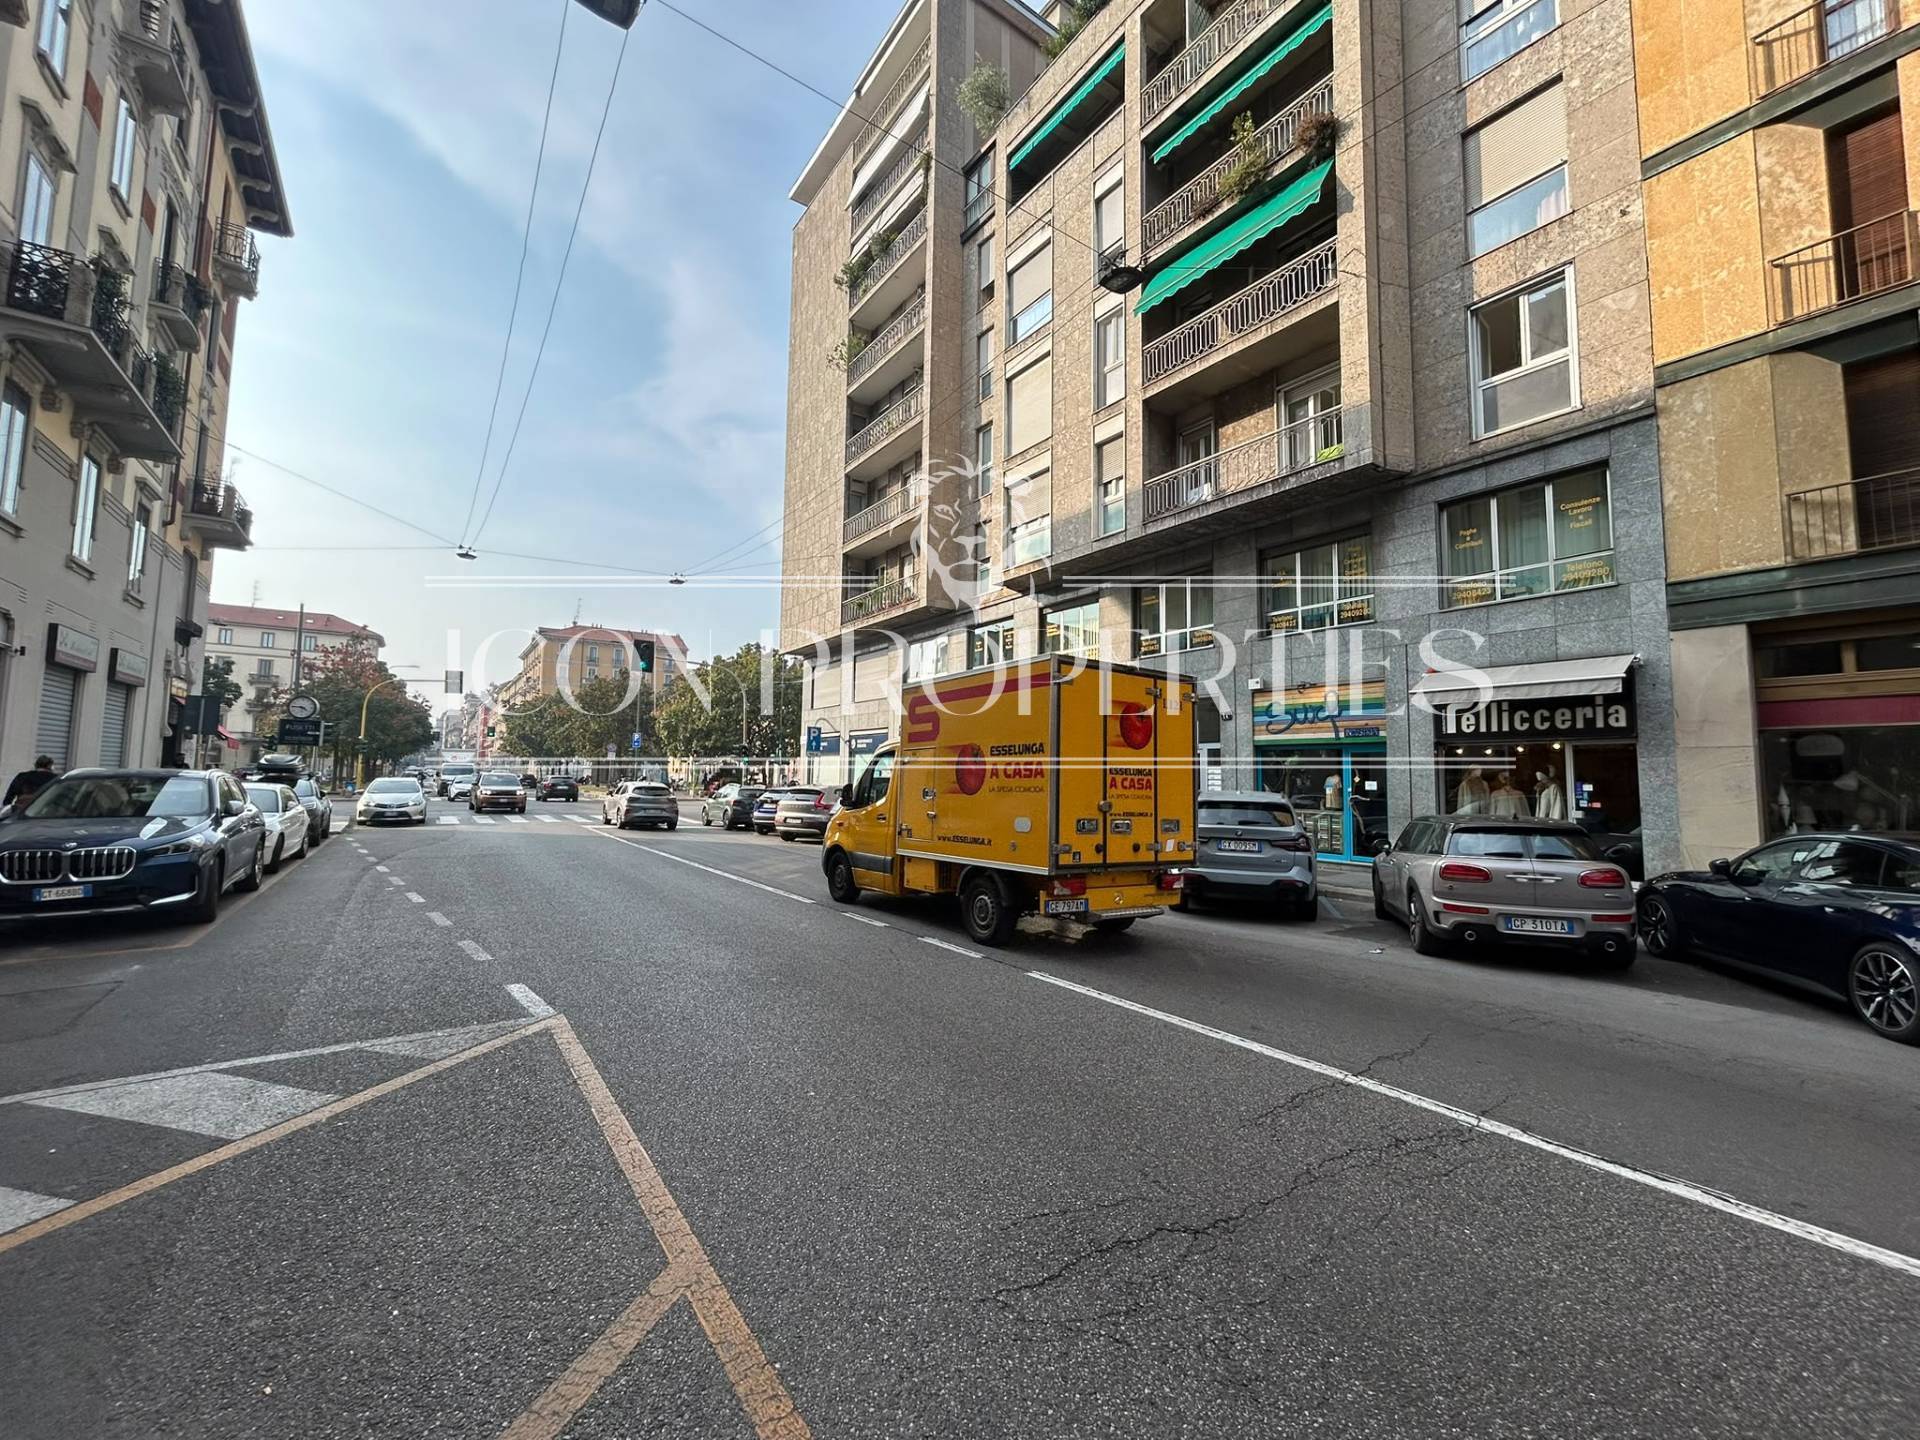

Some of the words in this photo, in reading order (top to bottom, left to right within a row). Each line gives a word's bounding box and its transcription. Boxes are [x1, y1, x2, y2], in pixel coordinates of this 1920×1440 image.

[1568, 505, 1593, 516] Lavoro
[1566, 560, 1604, 573] Telefono
[1446, 695, 1628, 735] Pellicceria
[989, 742, 1045, 757] ESSELUNGA
[990, 762, 999, 779] A
[1003, 760, 1045, 779] CASA
[1109, 767, 1152, 777] ESSELUNGA
[1109, 777, 1117, 790] A
[1121, 777, 1152, 791] CASA
[1531, 919, 1567, 931] 310TA
